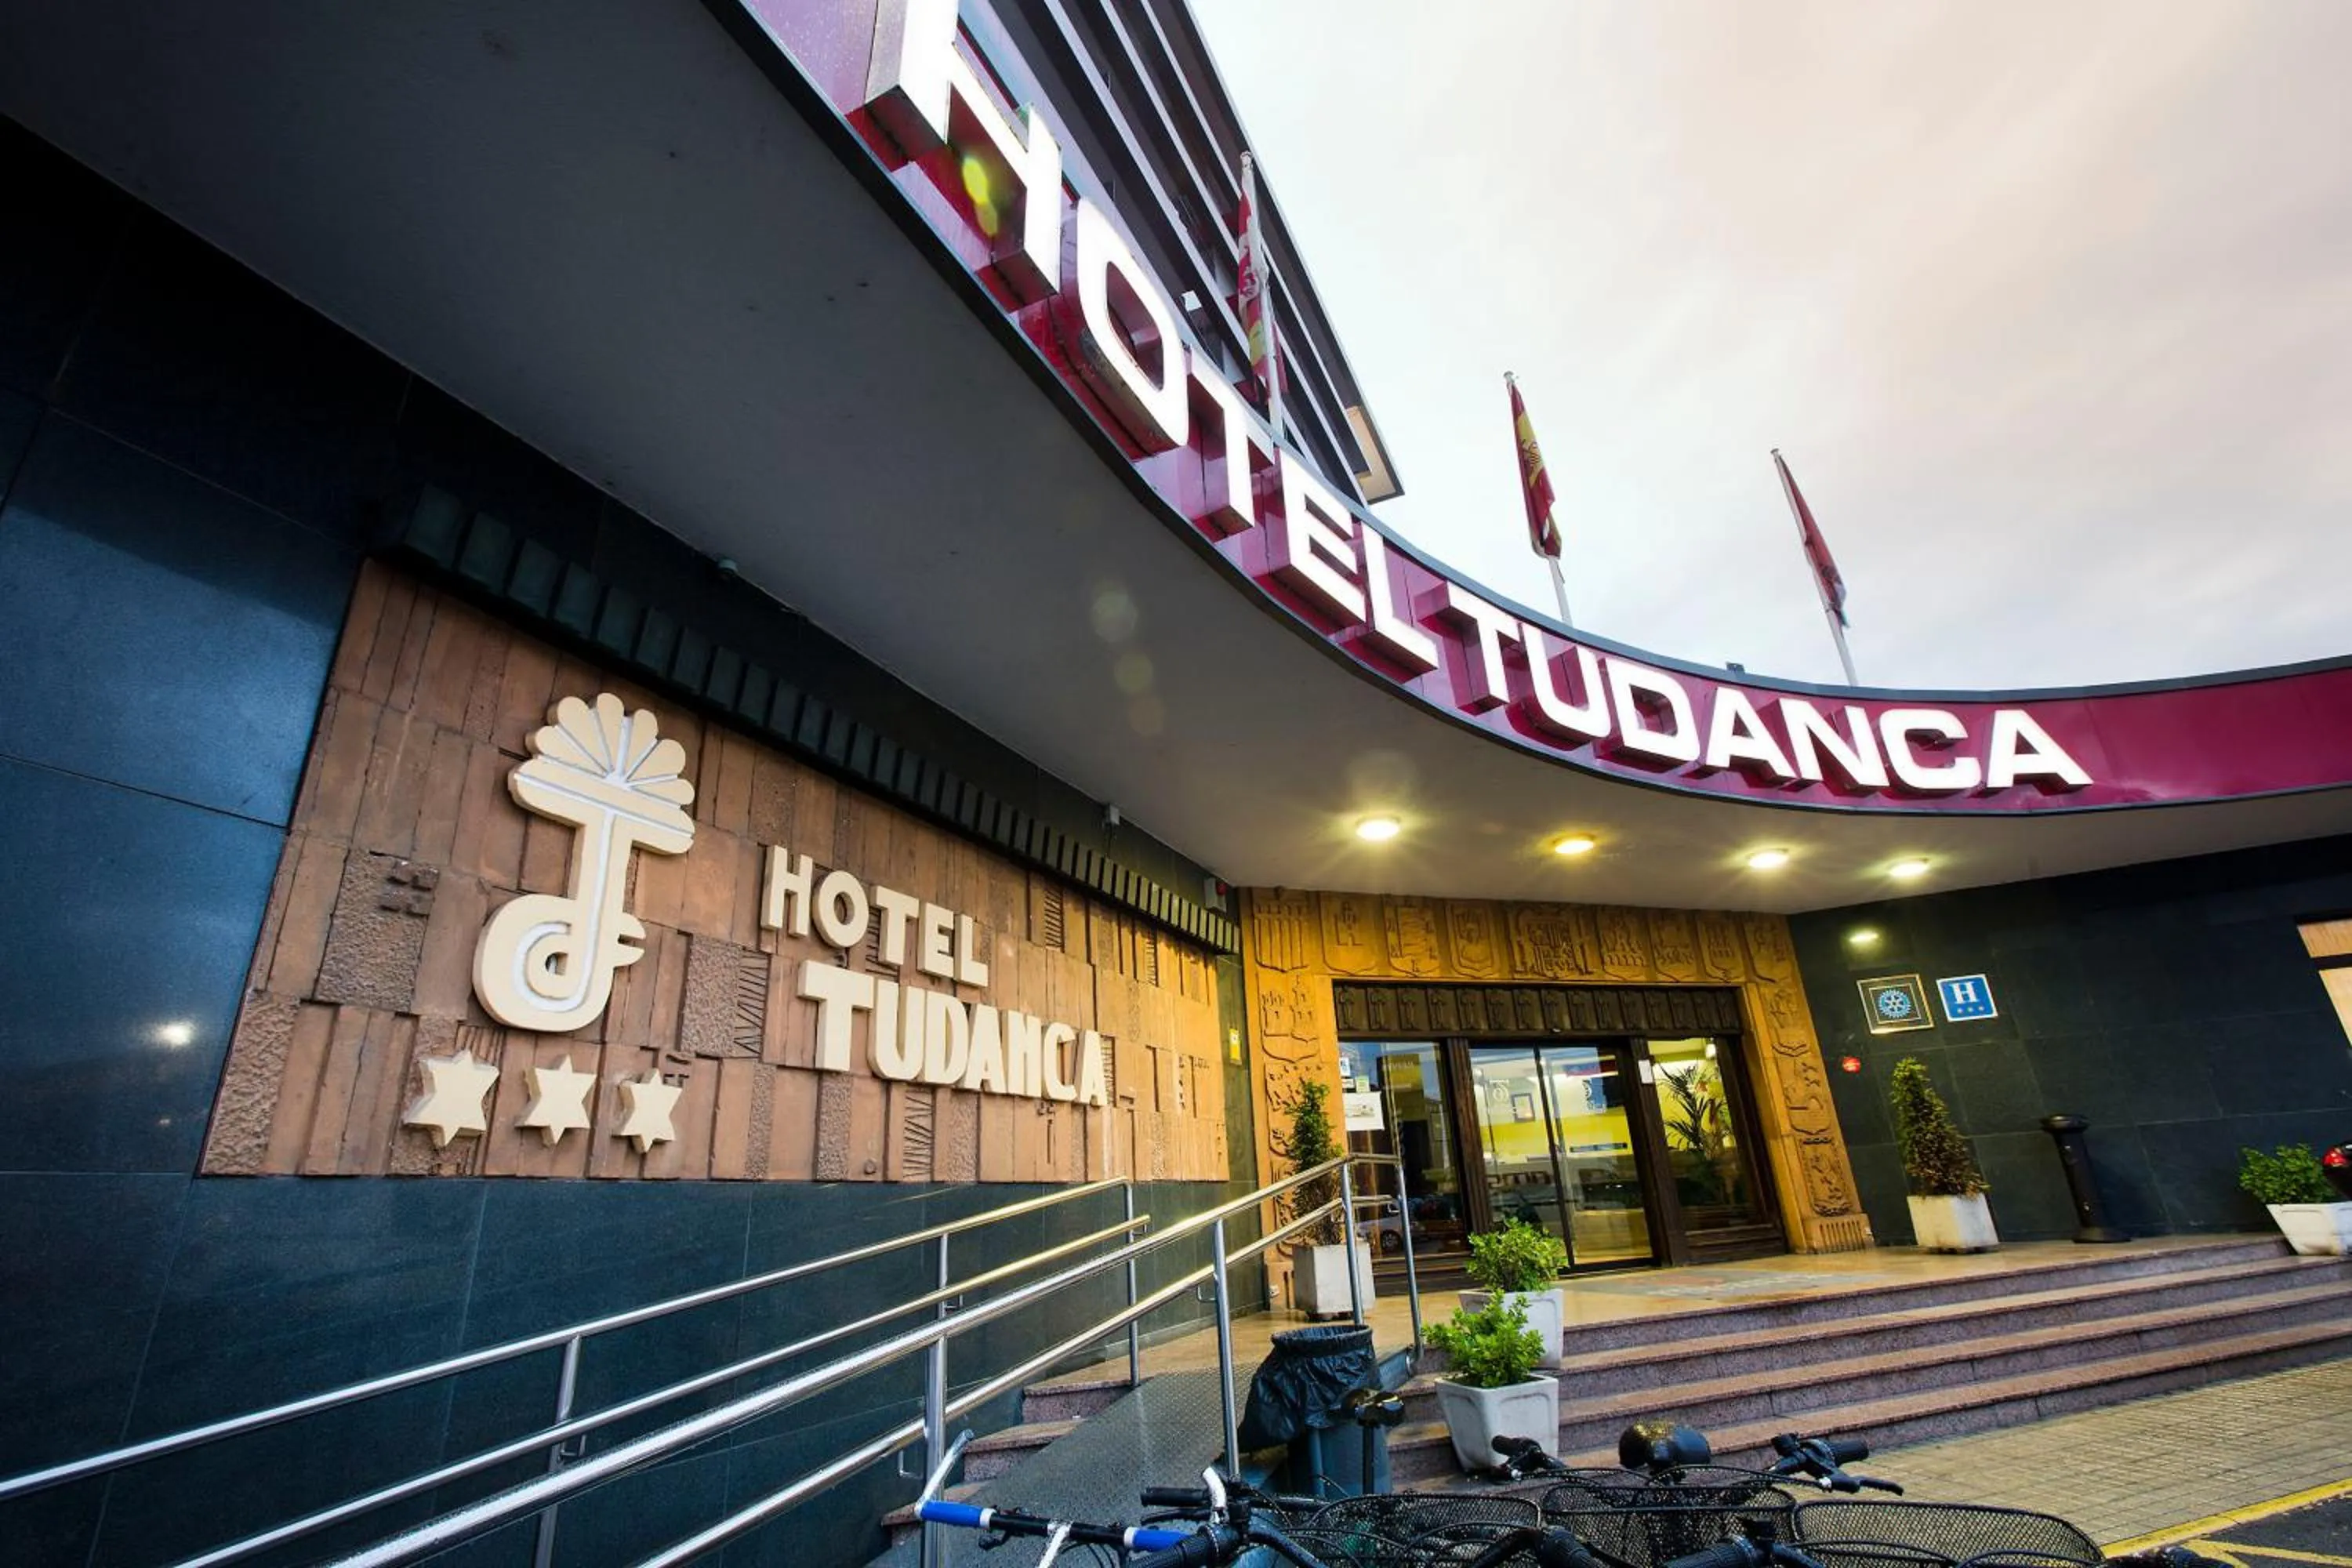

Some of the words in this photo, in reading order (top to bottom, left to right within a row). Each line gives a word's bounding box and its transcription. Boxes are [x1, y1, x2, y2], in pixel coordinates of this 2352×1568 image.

[891, 0, 1439, 672] HOTEL
[1444, 580, 2095, 790] TUDANCA
[760, 844, 989, 988] HOTEL
[797, 960, 1108, 1107] TUDANCA
[1950, 982, 1979, 1004] H
